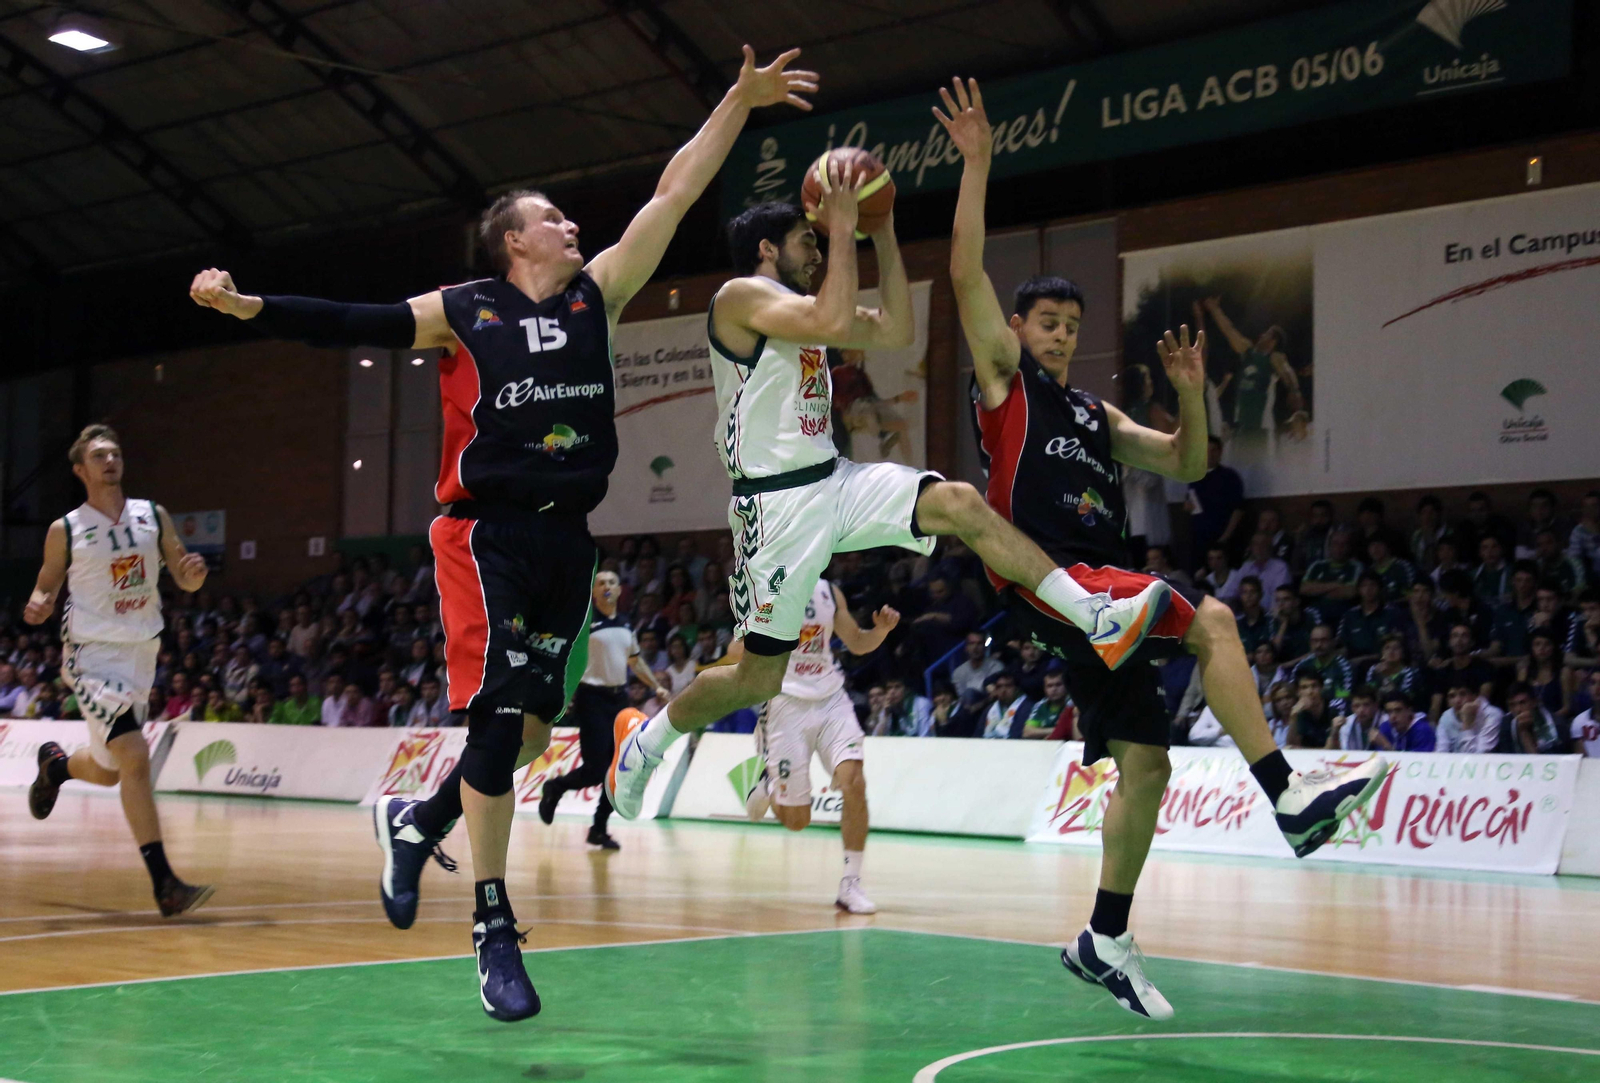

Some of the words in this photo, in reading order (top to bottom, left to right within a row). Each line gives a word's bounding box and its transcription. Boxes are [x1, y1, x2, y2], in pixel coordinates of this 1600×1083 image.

[1423, 52, 1501, 84] Unicaja
[1101, 83, 1188, 128] LIGA
[1197, 64, 1280, 110] ACB
[1290, 41, 1385, 91] 05/06
[1444, 242, 1473, 264] En
[1481, 237, 1501, 259] el
[1508, 228, 1600, 255] Campu
[518, 316, 568, 354] 15
[614, 353, 631, 369] En
[634, 350, 651, 367] las
[533, 382, 605, 402] AirEuropa
[107, 526, 138, 552] 11
[767, 565, 788, 596] 4
[225, 767, 282, 792] Unicaja
[778, 758, 791, 779] 6
[1406, 761, 1559, 782] CLINICAS
